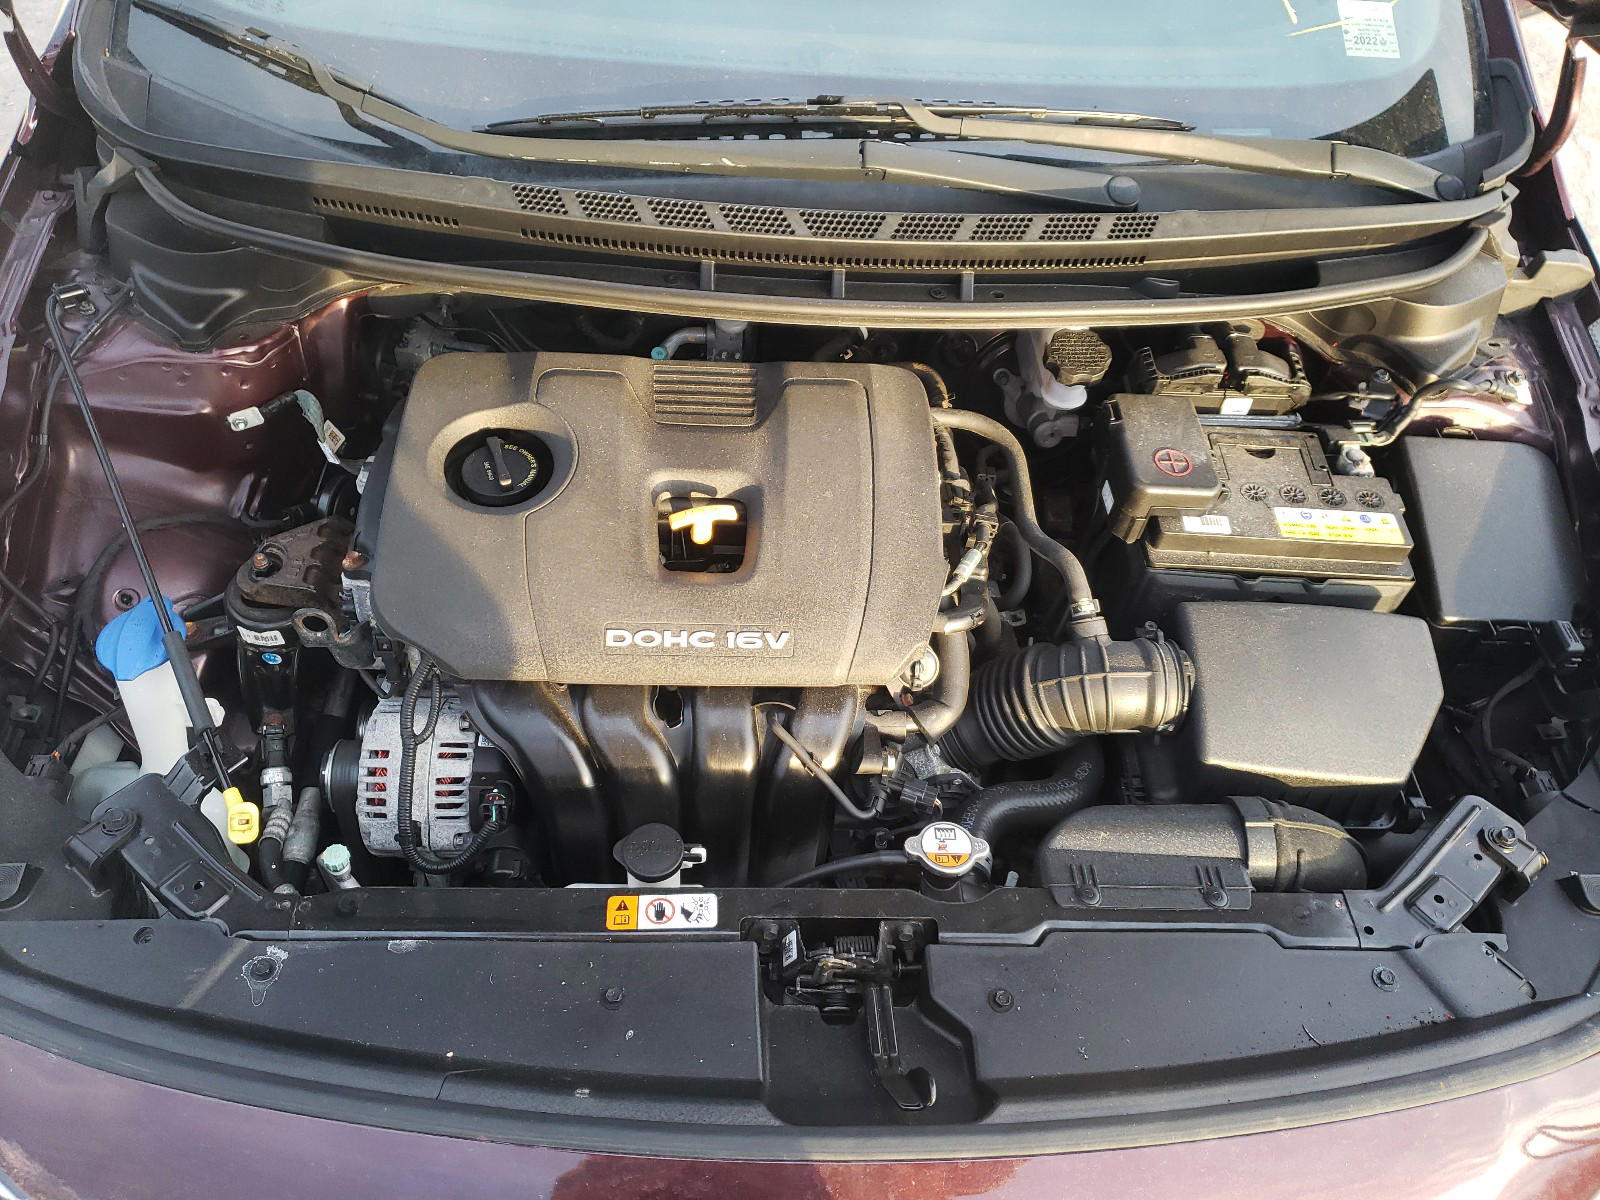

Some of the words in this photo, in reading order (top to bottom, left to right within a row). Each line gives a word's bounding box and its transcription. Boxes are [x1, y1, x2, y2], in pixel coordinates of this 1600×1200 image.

[1353, 35, 1379, 46] 2022
[516, 468, 537, 488] MANUAL
[604, 628, 716, 648] DOHC
[726, 630, 790, 650] 16V
